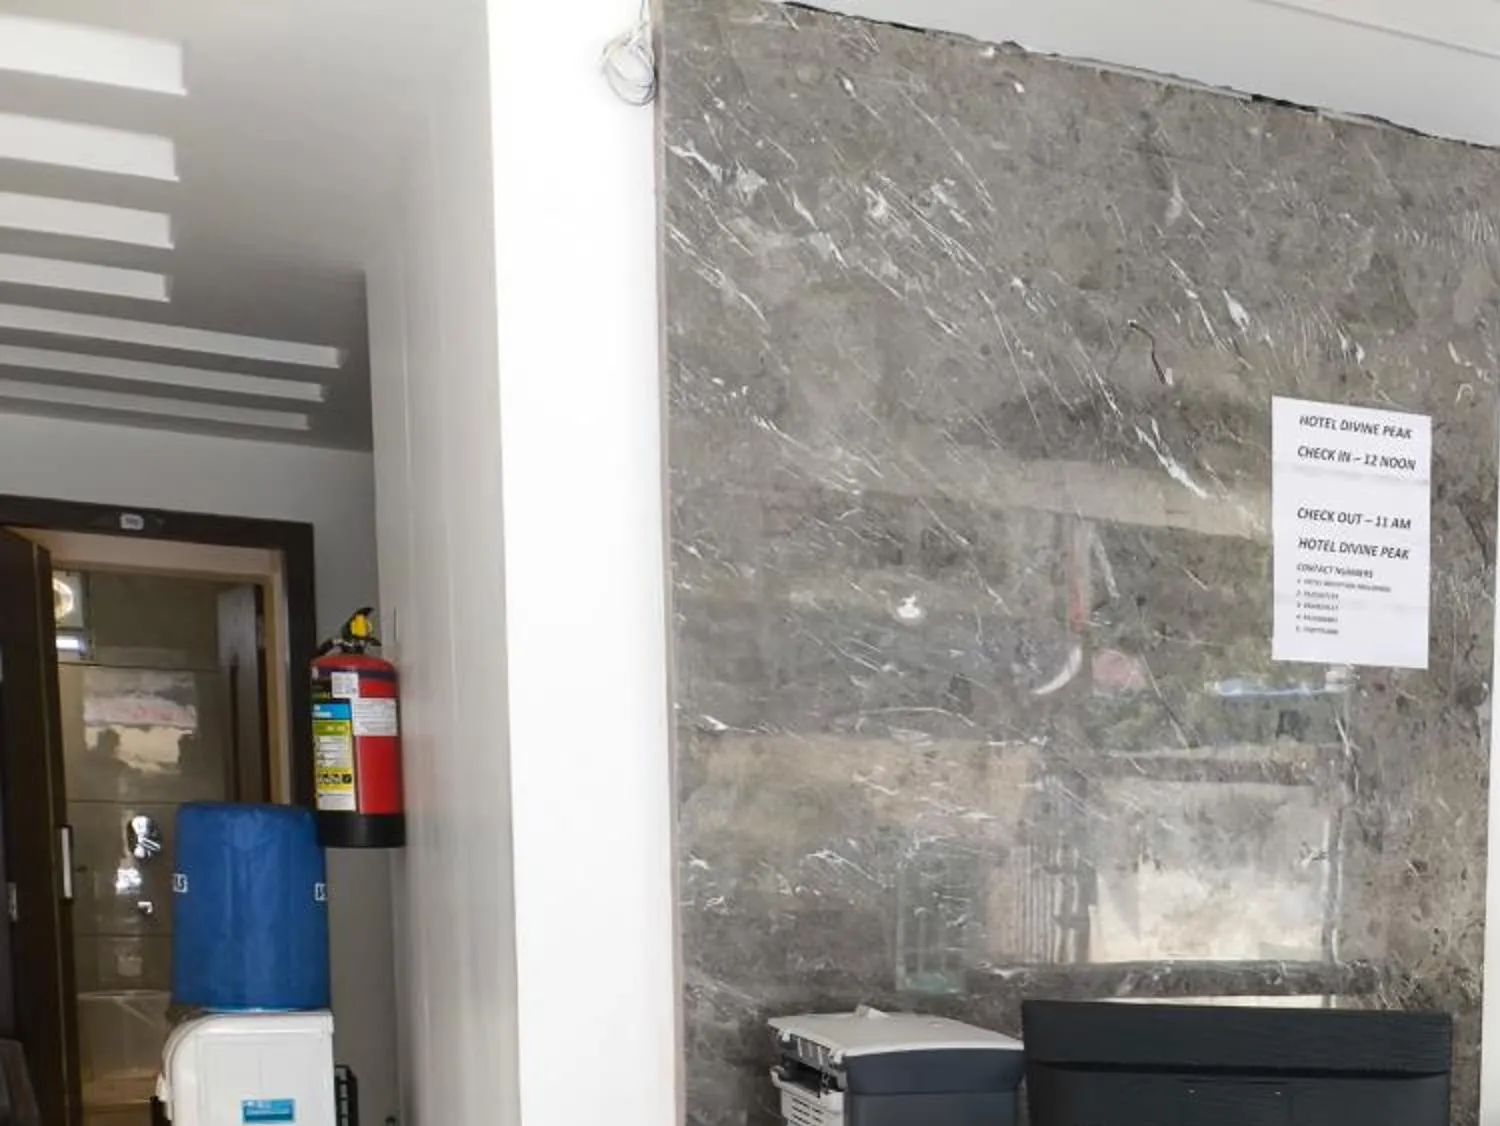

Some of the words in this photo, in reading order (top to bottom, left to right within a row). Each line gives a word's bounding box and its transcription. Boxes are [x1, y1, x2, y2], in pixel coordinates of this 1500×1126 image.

[1299, 415, 1337, 431] HOTEL
[1340, 419, 1381, 436] DIVINE
[1382, 424, 1413, 440] PEAK
[1297, 444, 1336, 461] CHECK
[1338, 449, 1352, 463] IN
[1364, 452, 1378, 467] 12
[1379, 454, 1417, 471] NOON
[1297, 507, 1335, 522] CHECK
[1337, 511, 1363, 526] OUT
[1375, 515, 1389, 528] 11
[1390, 518, 1412, 529] AM
[1299, 536, 1336, 553] HOTEL
[1339, 541, 1379, 557] DIVINE
[1380, 546, 1411, 560] PEAK
[1296, 563, 1335, 575] CONTACT
